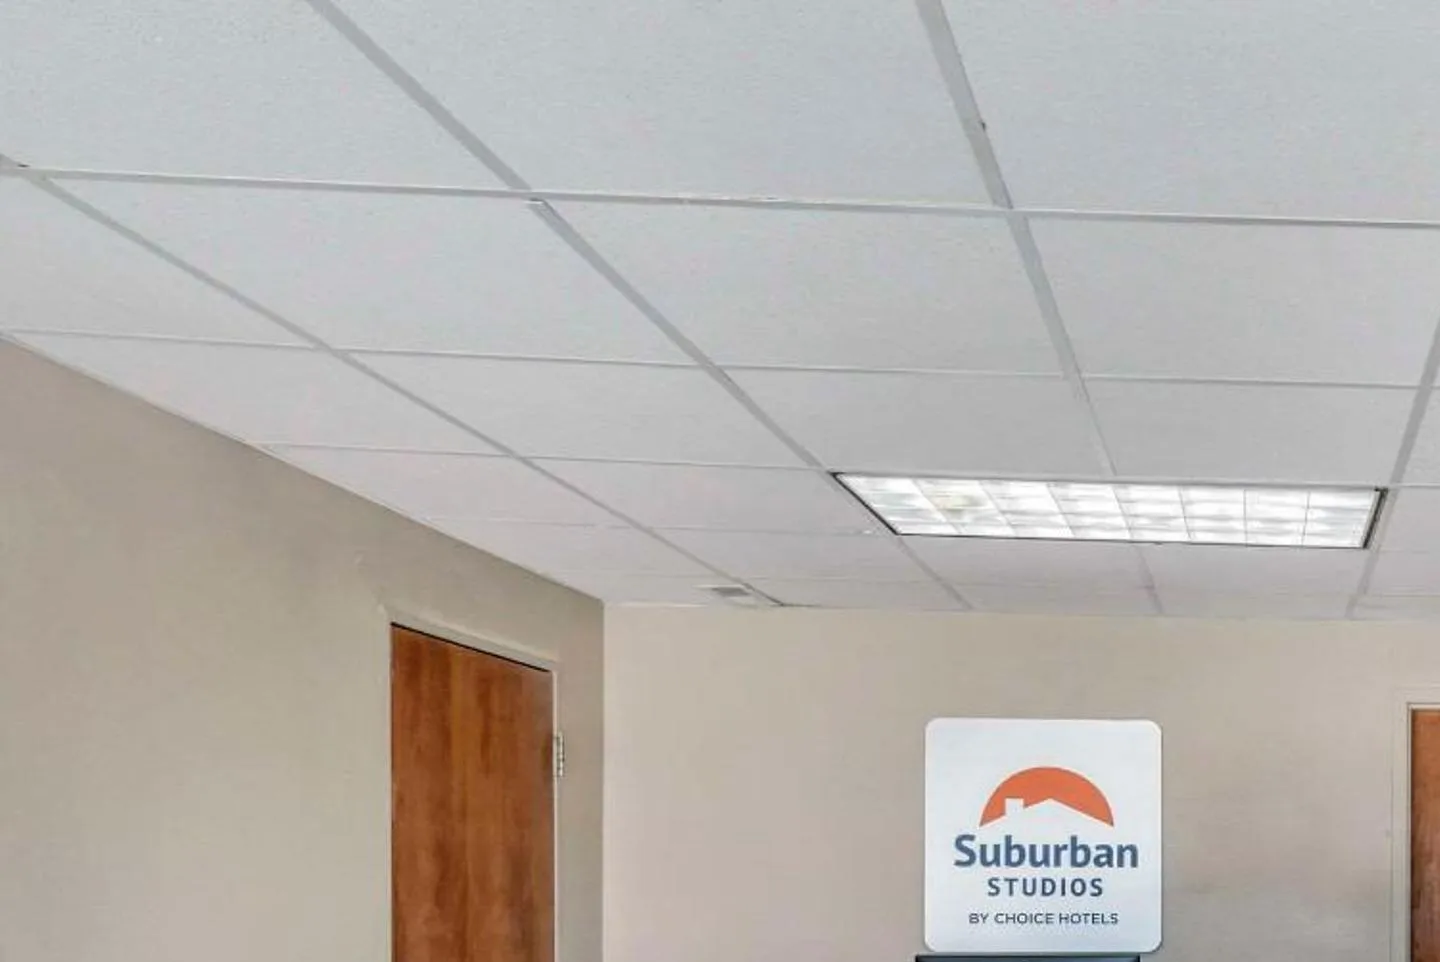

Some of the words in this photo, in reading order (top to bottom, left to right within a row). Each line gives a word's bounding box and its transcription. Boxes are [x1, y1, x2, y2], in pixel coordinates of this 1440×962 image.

[953, 834, 1139, 868] Suburban
[987, 877, 1103, 897] STUDIOS
[969, 913, 988, 924] BY
[994, 912, 1054, 924] CHOICE
[1059, 912, 1119, 924] HOTELS
